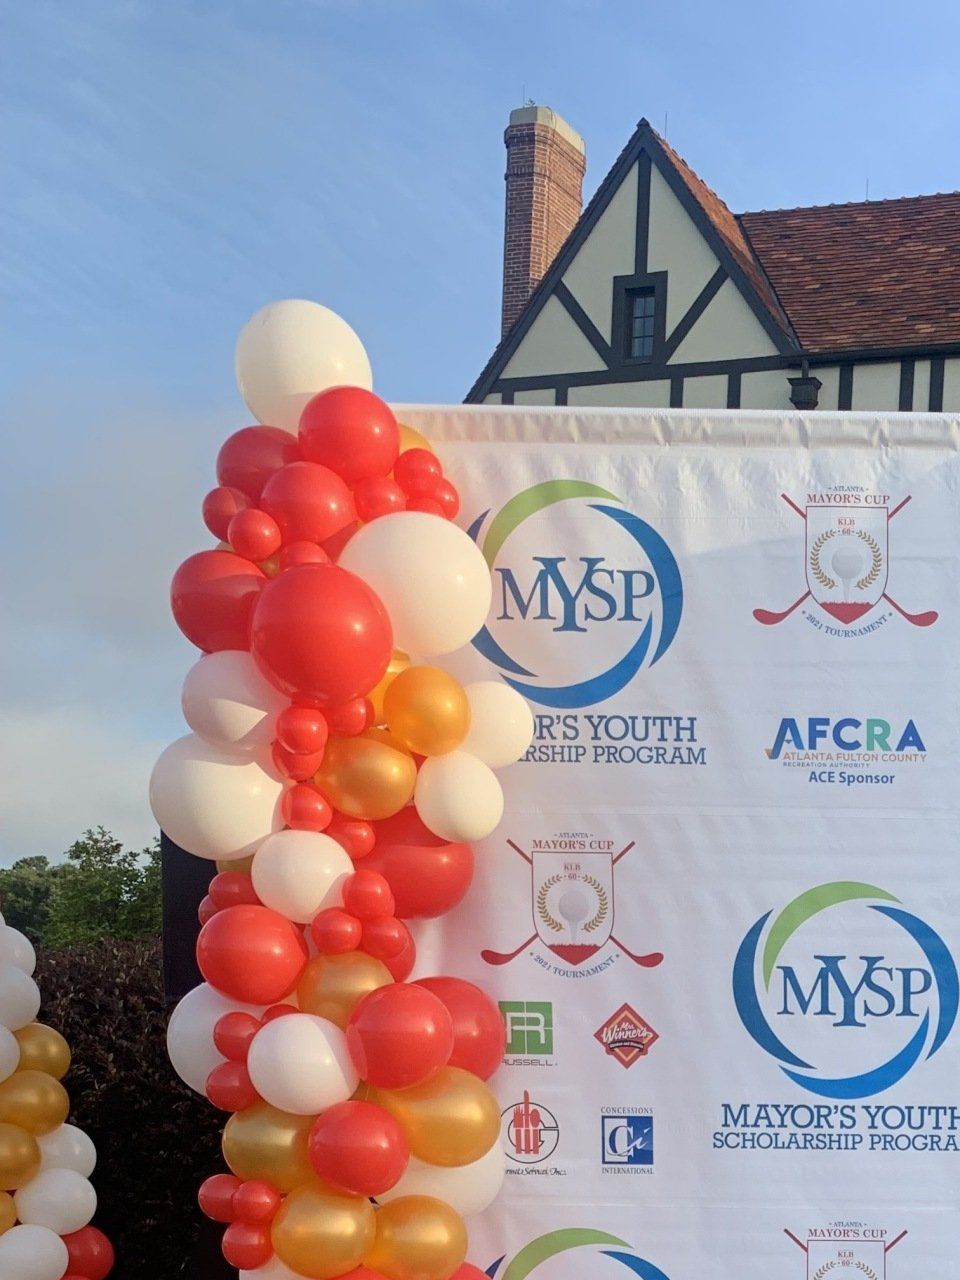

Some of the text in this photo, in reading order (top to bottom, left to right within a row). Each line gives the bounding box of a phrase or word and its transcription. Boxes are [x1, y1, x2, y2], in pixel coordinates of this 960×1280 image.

[806, 494, 890, 505] MAYOR'S CUP
[494, 556, 655, 633] MYSP
[806, 614, 889, 638] 2021 TOURNAMENT
[533, 714, 698, 743] R'S YOUTH
[766, 717, 927, 758] AFCRA
[517, 745, 707, 765] RSHIP PROGRAM
[783, 752, 927, 763] ATLANTA FULTON COUNTY
[808, 771, 895, 786] ACE Sponsor
[532, 839, 614, 850] MAYOR'S CUP
[534, 954, 617, 978] 2021 TOURNAMENT
[776, 955, 933, 1028] MYSP
[600, 1106, 654, 1114] CONCESSIONS
[721, 1103, 856, 1129] MAYOR'S
[712, 1131, 863, 1151] SCHOLARSHIP
[807, 1228, 888, 1238] MAYOR'S CUP
